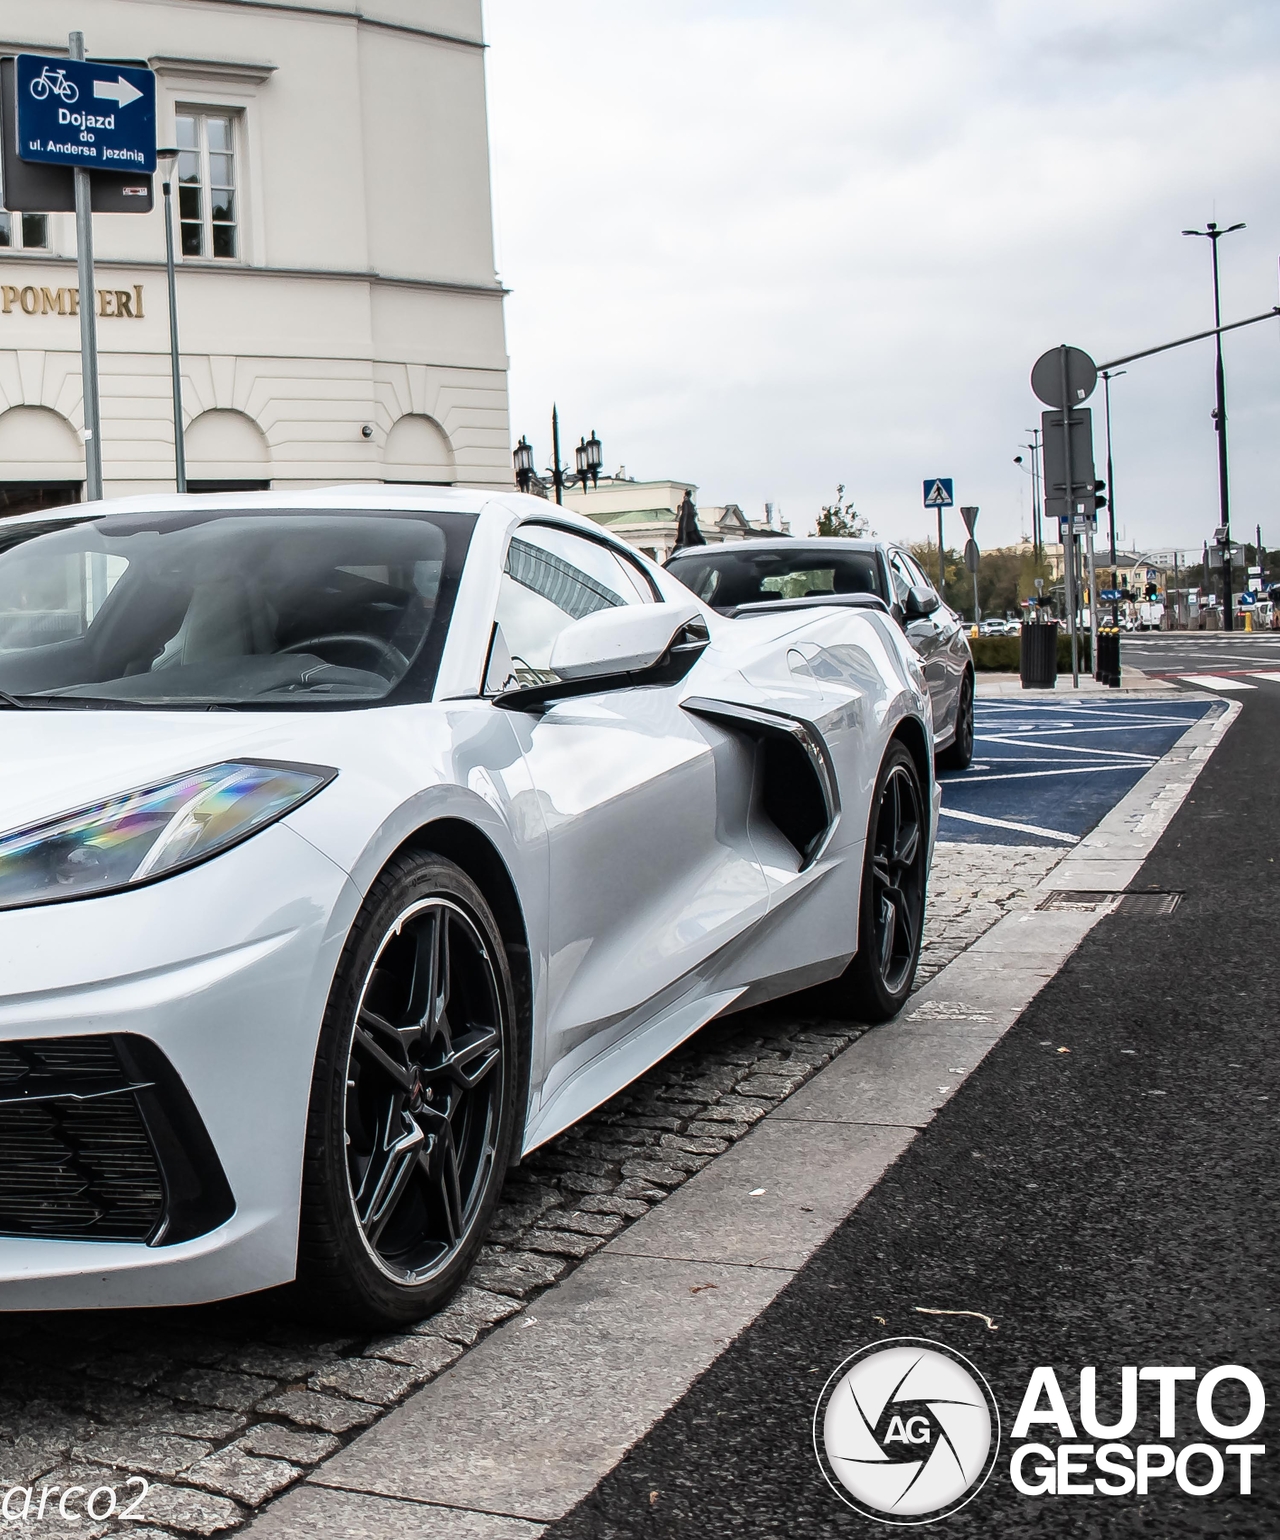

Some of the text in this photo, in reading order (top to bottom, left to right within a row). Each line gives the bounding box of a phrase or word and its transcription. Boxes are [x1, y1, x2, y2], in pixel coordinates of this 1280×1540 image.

[58, 108, 115, 130] Dojazd
[79, 130, 95, 143] do
[29, 139, 145, 164] ul. Andersa jezdnią
